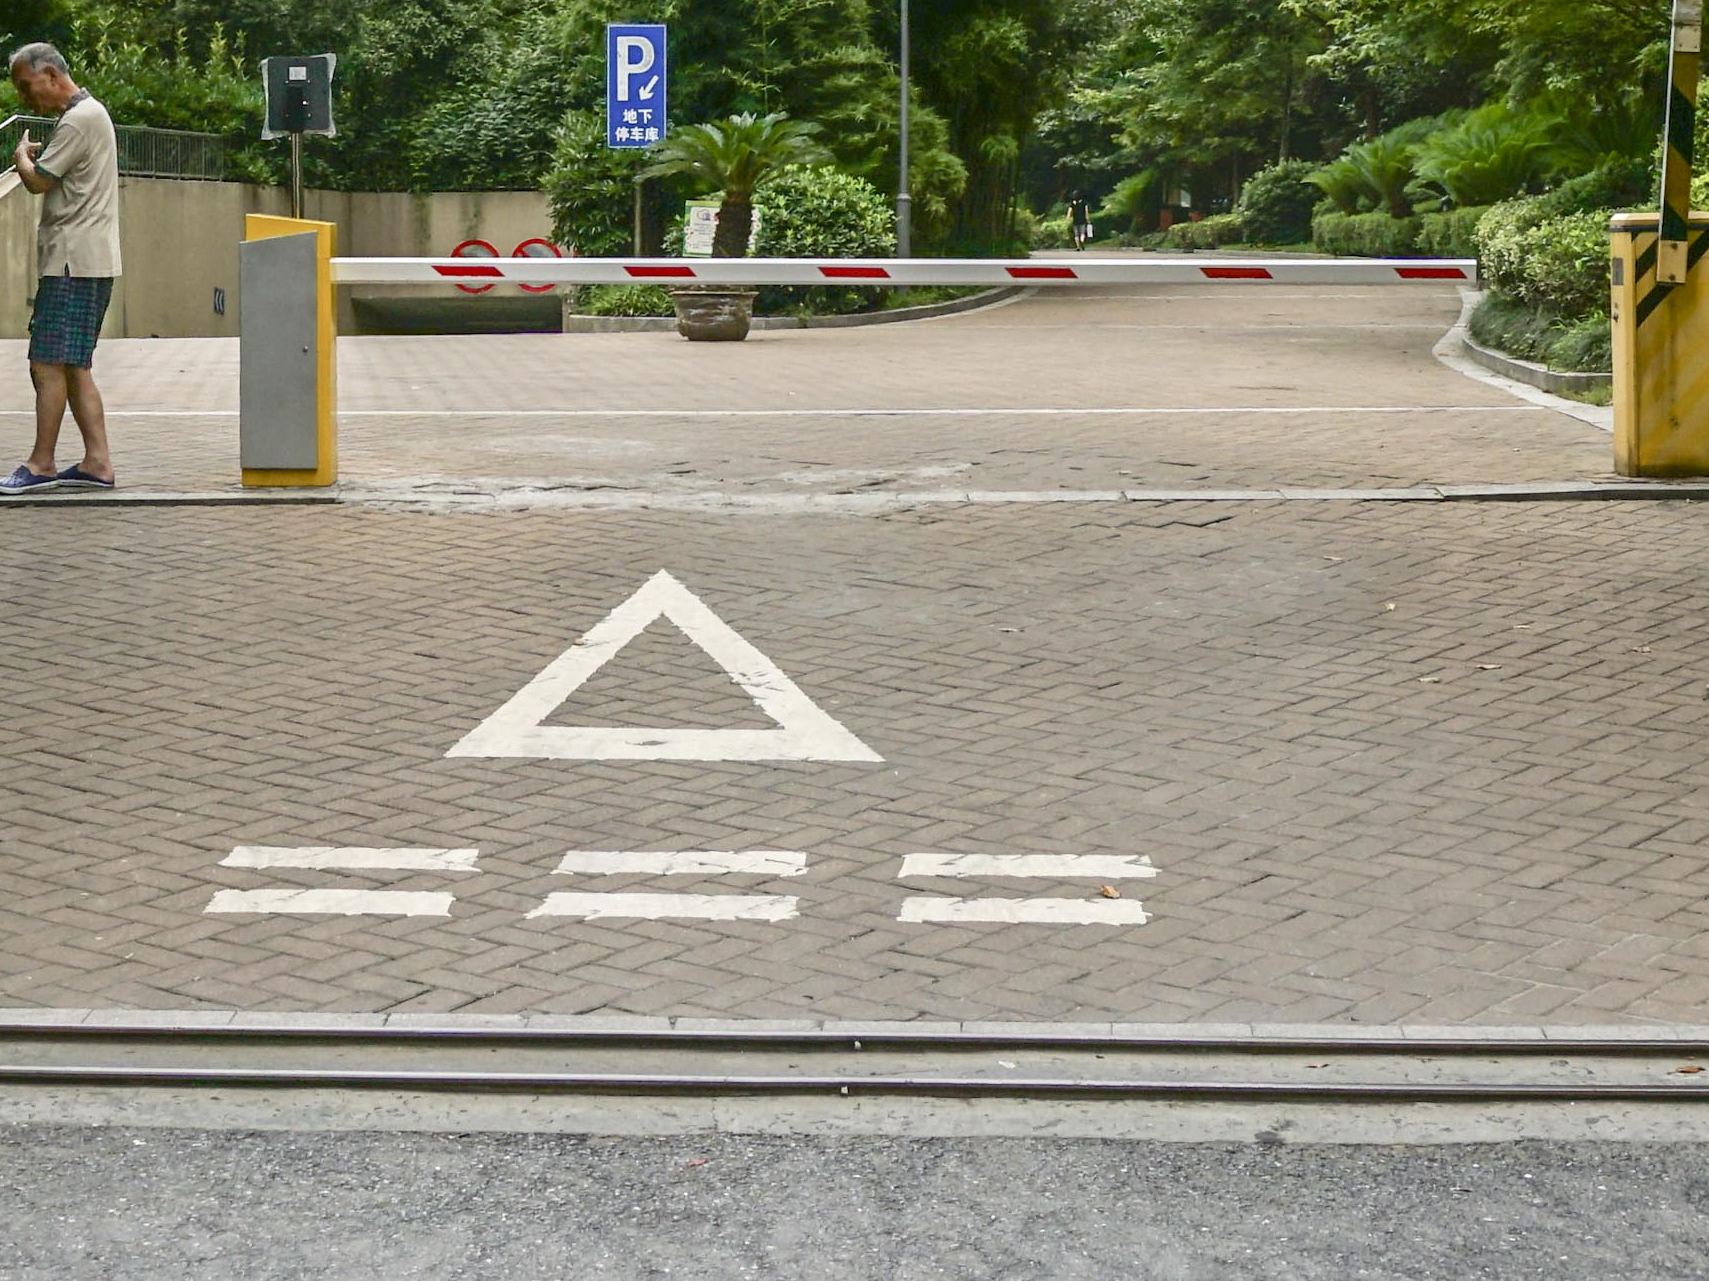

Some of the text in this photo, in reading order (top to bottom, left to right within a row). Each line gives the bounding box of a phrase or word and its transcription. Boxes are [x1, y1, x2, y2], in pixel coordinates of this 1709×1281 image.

[617, 36, 655, 101] P
[623, 108, 653, 124] 地下
[615, 127, 659, 142] 停车库
